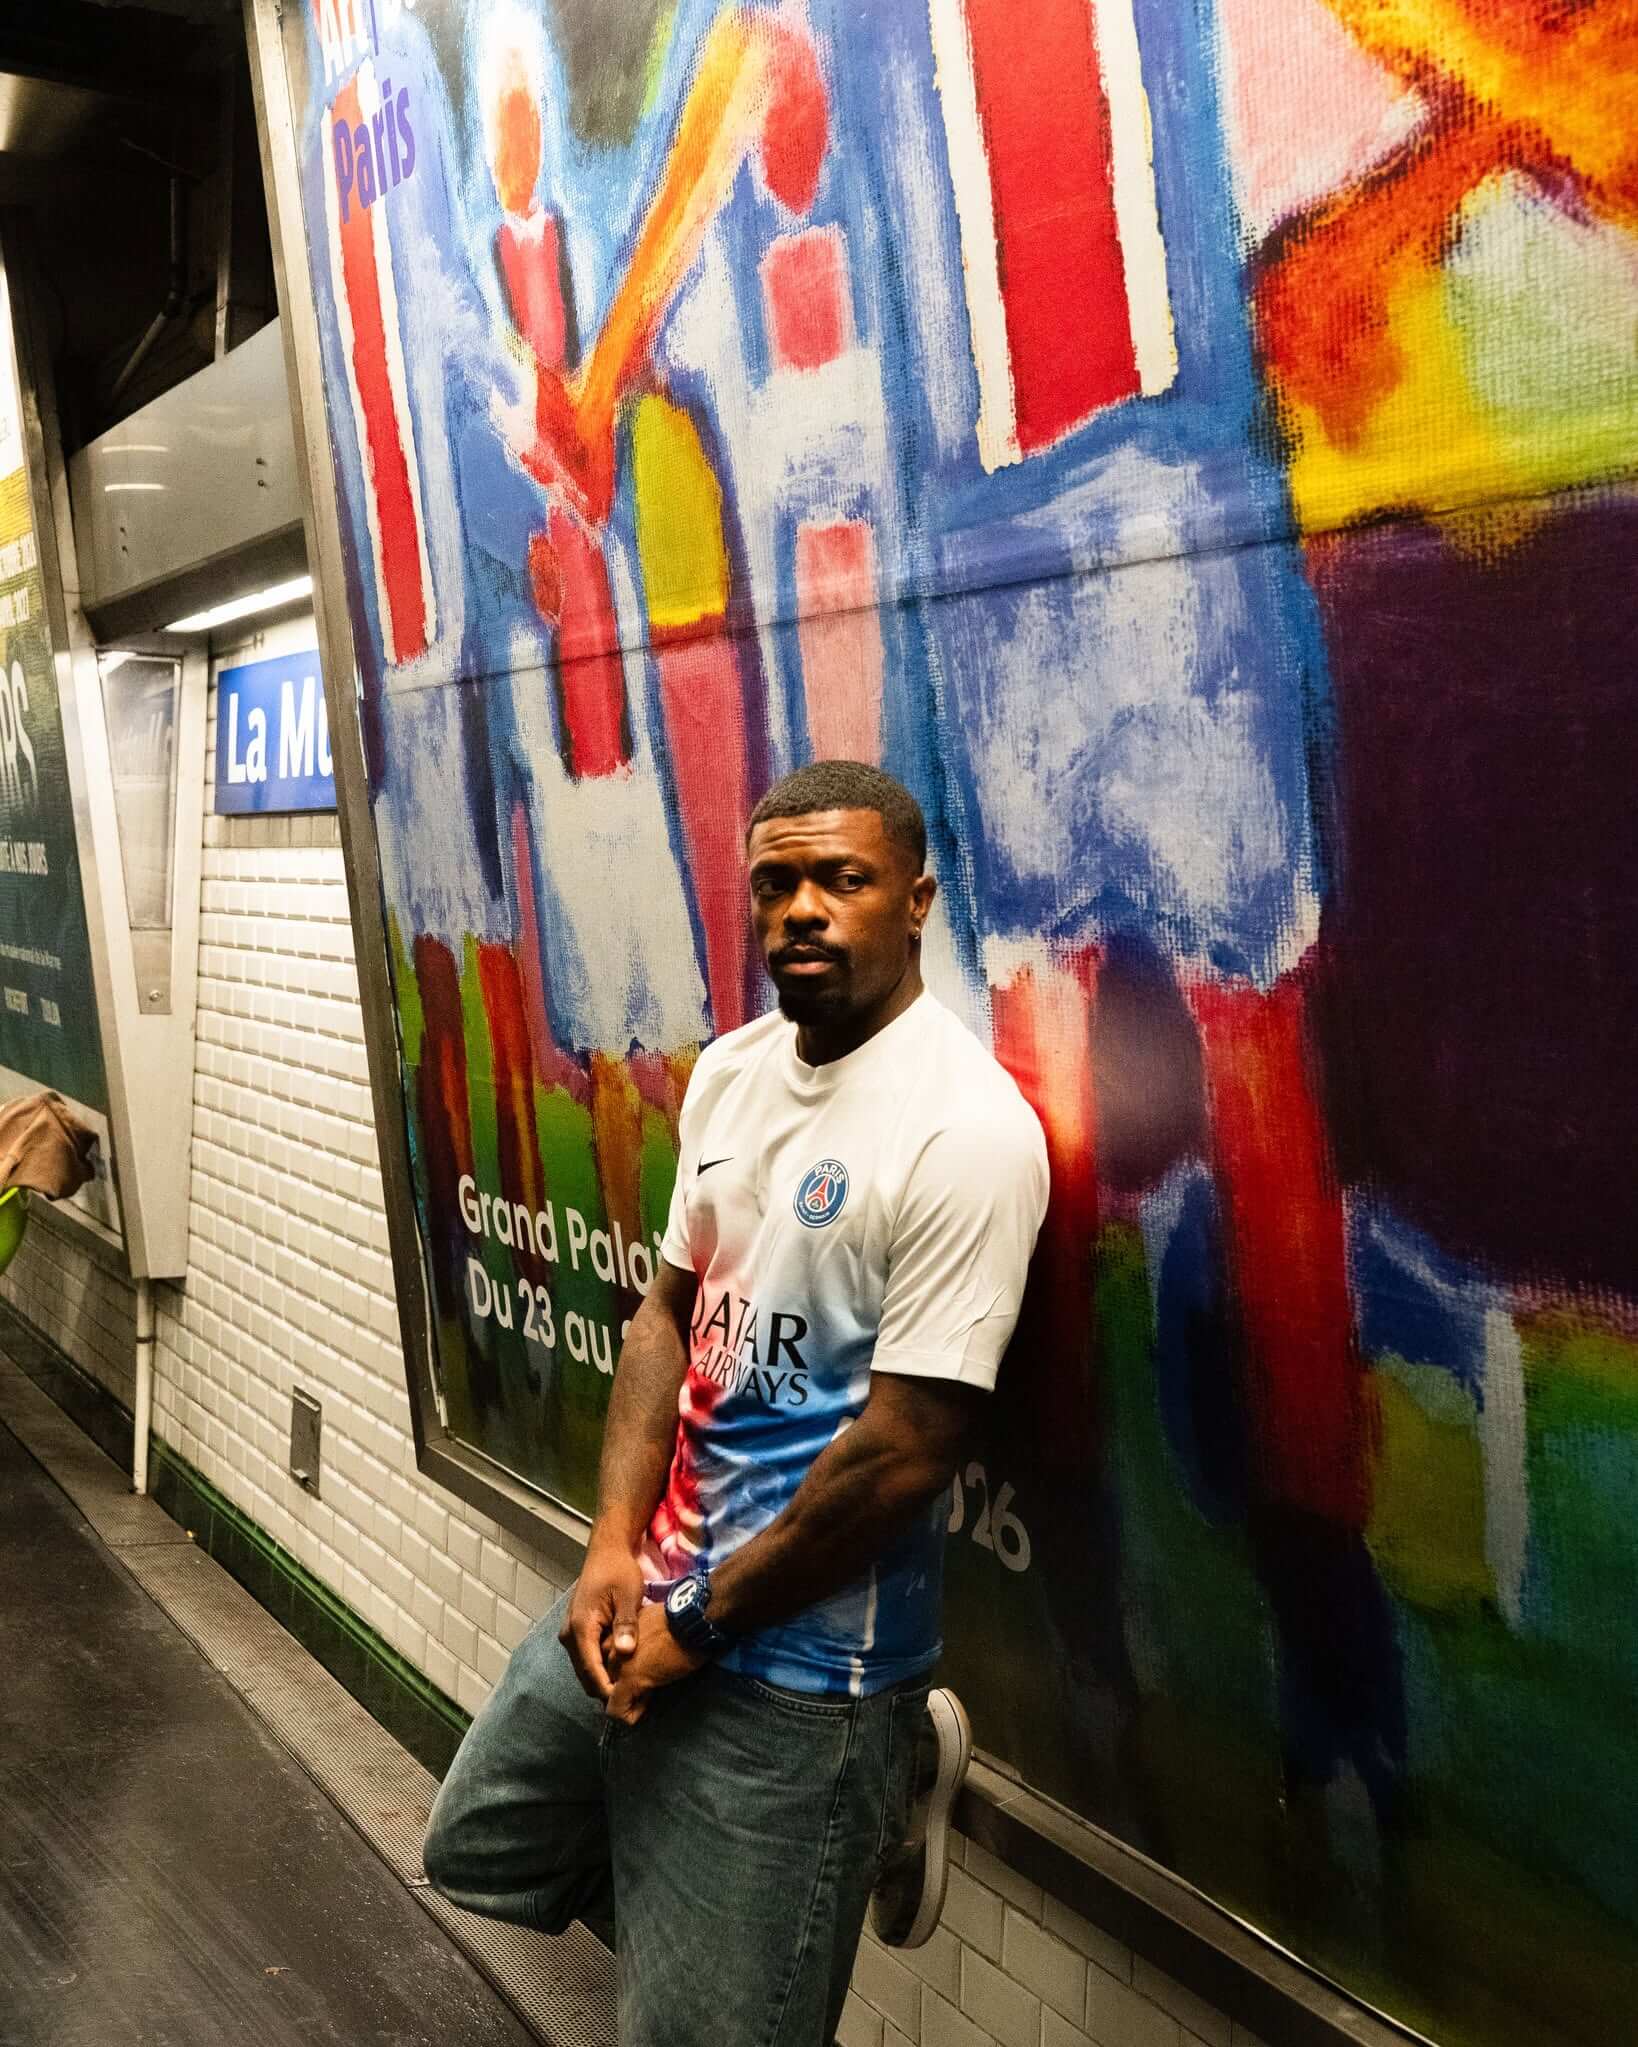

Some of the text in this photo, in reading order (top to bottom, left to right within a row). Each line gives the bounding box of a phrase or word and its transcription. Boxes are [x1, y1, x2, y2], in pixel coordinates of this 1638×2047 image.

[333, 77, 415, 224] Paris
[228, 692, 268, 784] La
[458, 1174, 559, 1263] Grand
[814, 1164, 845, 1184] PARIS
[467, 1257, 613, 1375] Du 23 au
[694, 1346, 808, 1406] AIRWAYS
